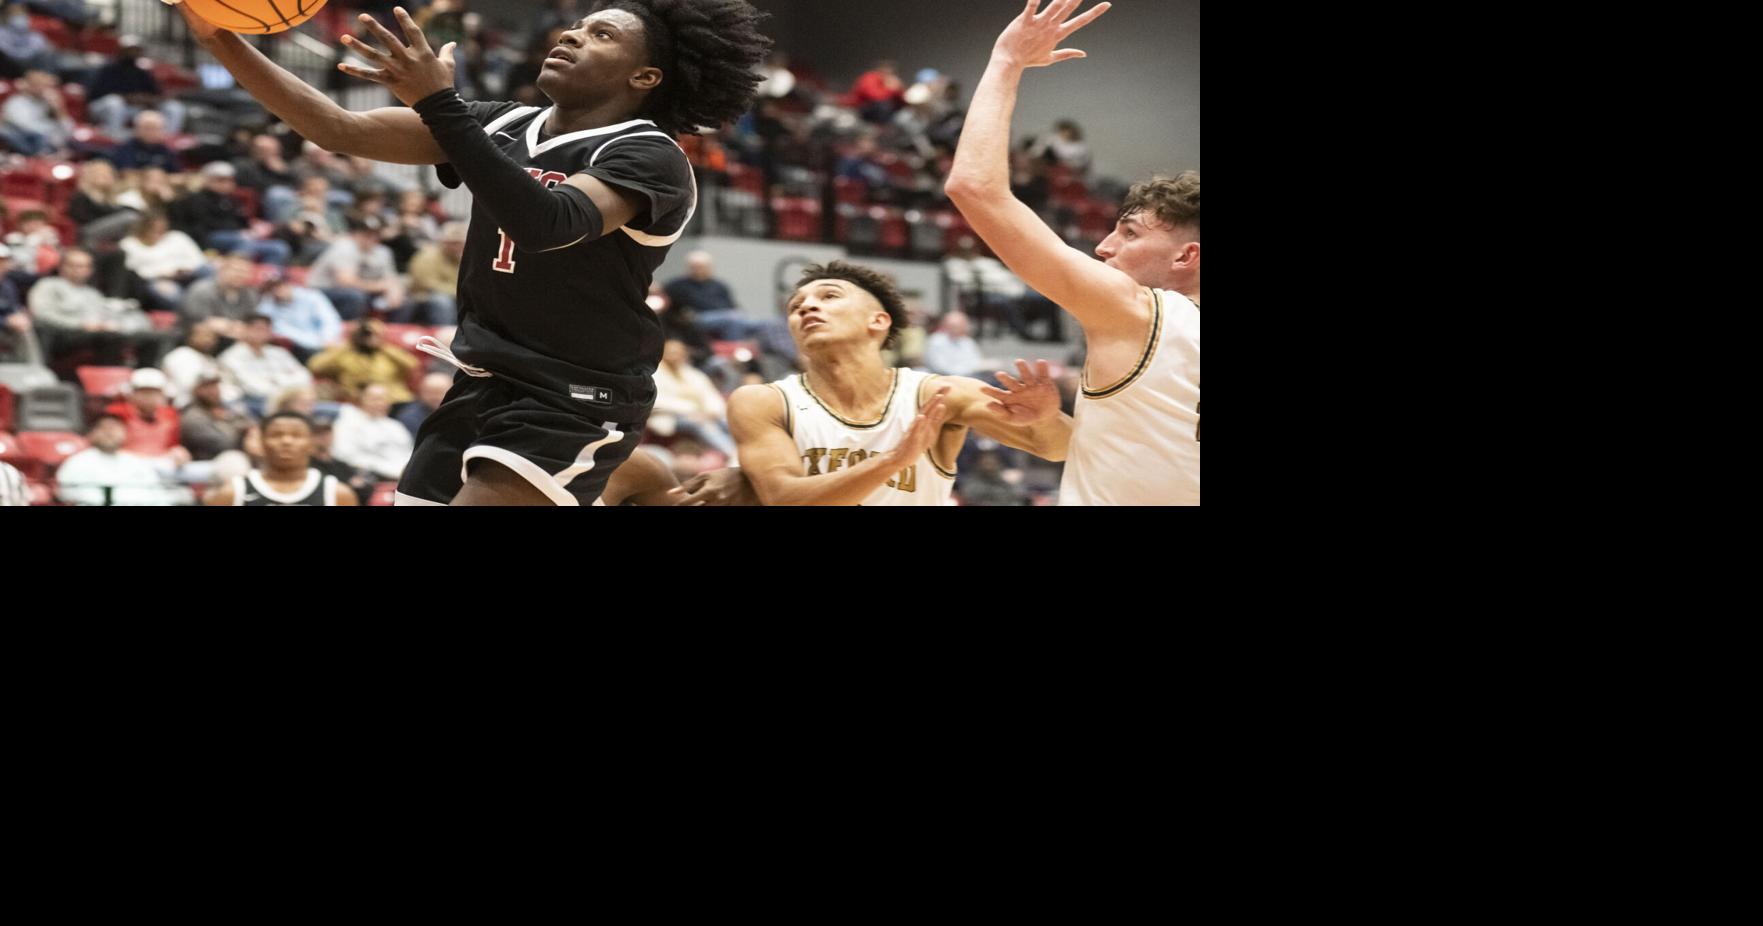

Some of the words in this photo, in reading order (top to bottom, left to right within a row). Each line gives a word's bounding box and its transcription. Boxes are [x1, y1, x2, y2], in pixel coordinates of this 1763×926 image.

[492, 226, 516, 274] 1
[599, 391, 608, 400] M
[800, 447, 917, 493] XFOD
